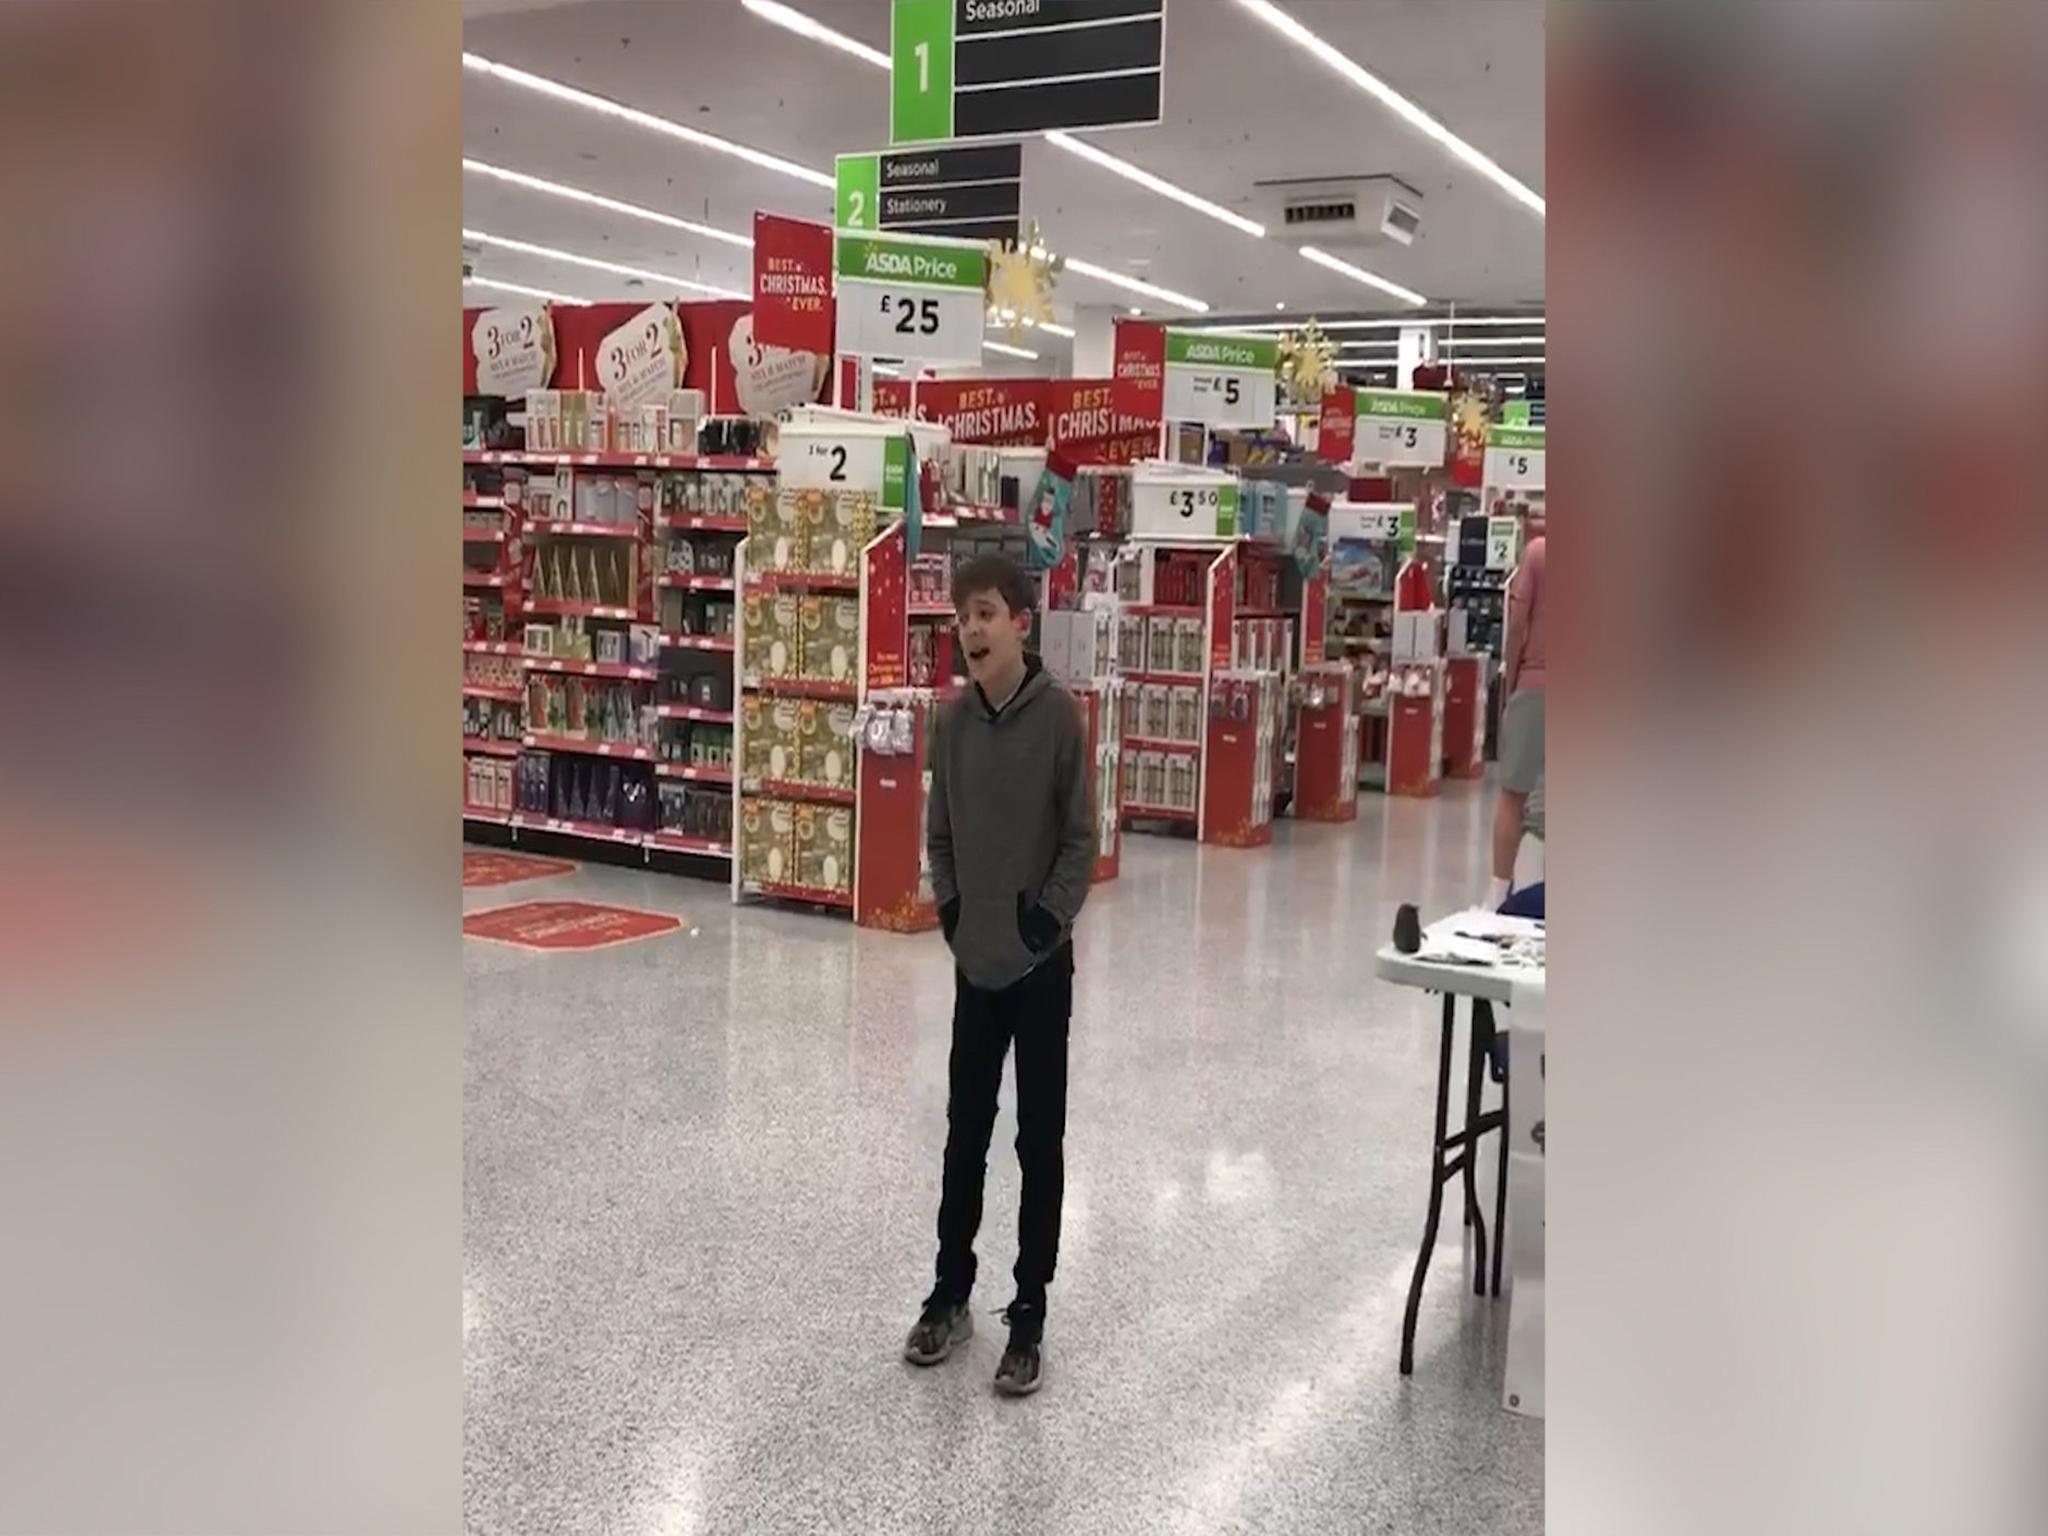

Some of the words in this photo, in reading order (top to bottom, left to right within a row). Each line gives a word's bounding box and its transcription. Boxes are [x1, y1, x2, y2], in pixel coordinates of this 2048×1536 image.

[965, 0, 1039, 21] Seasonal
[914, 42, 928, 93] 1
[886, 158, 940, 179] Seasonal
[848, 190, 865, 226] 2
[886, 197, 947, 215] Stationery
[865, 253, 911, 276] ASDA
[913, 255, 957, 279] Price
[487, 326, 501, 359] 3
[520, 315, 534, 349] 2
[611, 346, 627, 381] 3
[645, 322, 662, 359] 2
[1221, 347, 1255, 364] Price
[829, 445, 847, 481] 2
